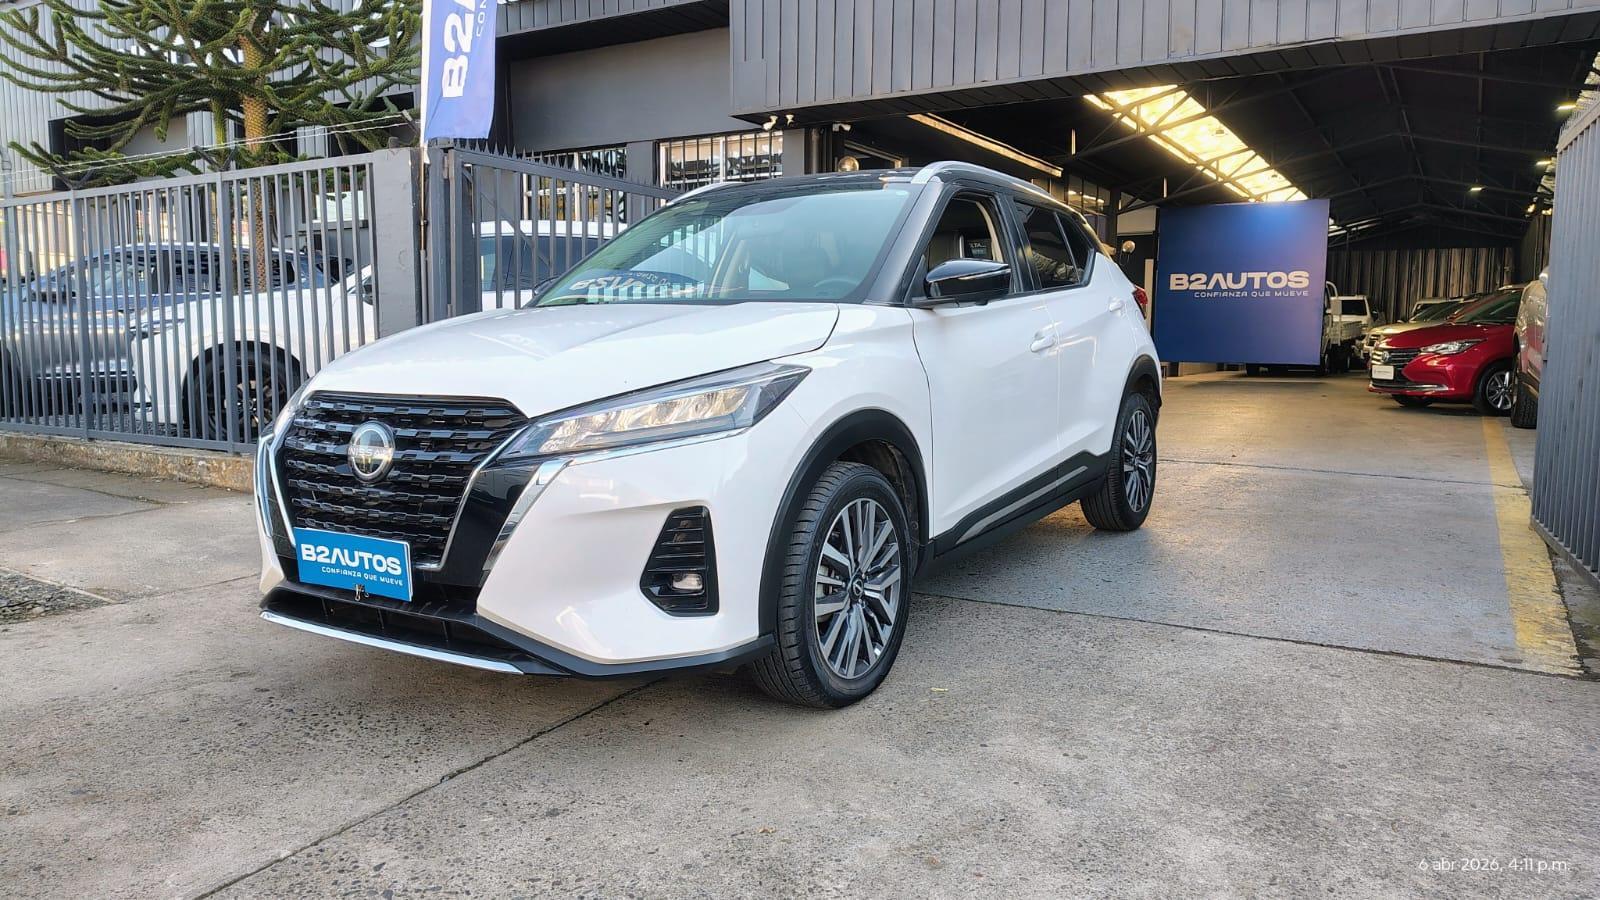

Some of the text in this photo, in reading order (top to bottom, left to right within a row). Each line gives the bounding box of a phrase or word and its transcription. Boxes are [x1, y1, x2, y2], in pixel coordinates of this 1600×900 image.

[442, 0, 475, 97] B2
[1169, 271, 1310, 290] B2AUTOS
[301, 544, 402, 575] B2AUTOS
[321, 566, 403, 586] CONFIANZA QUE MUEVE
